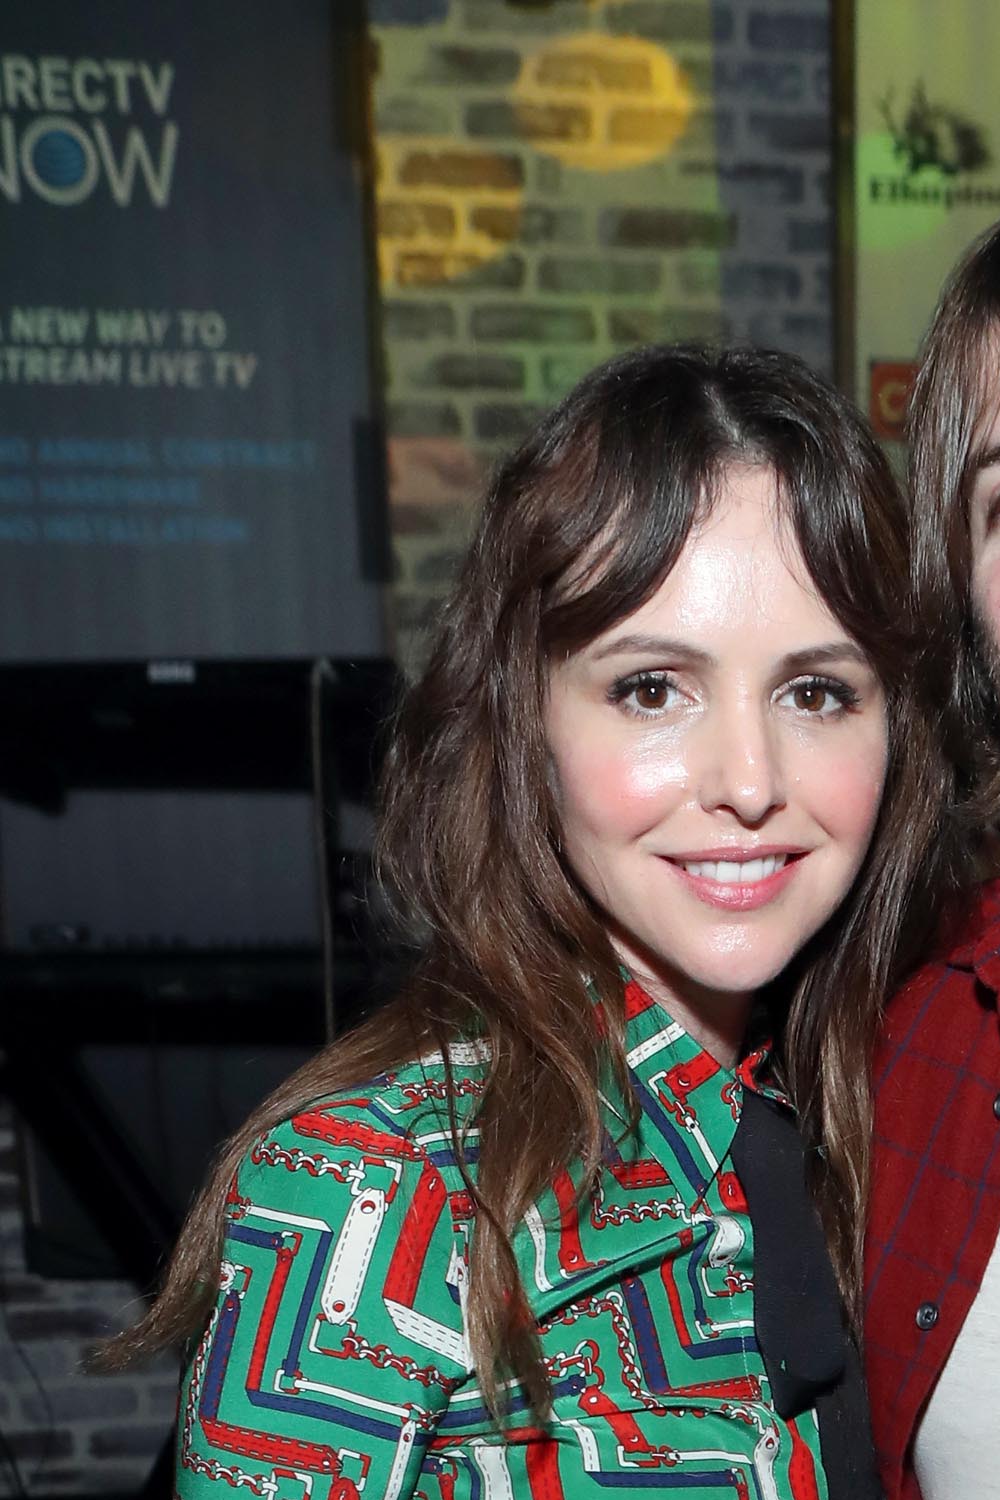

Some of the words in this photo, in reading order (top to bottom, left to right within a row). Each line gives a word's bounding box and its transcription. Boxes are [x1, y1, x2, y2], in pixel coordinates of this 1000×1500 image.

[10, 306, 89, 345] NEW
[96, 308, 170, 347] WAY
[177, 310, 226, 348] TO
[0, 347, 122, 386] TREAM
[129, 350, 202, 388] LIVE
[211, 352, 257, 389] TV
